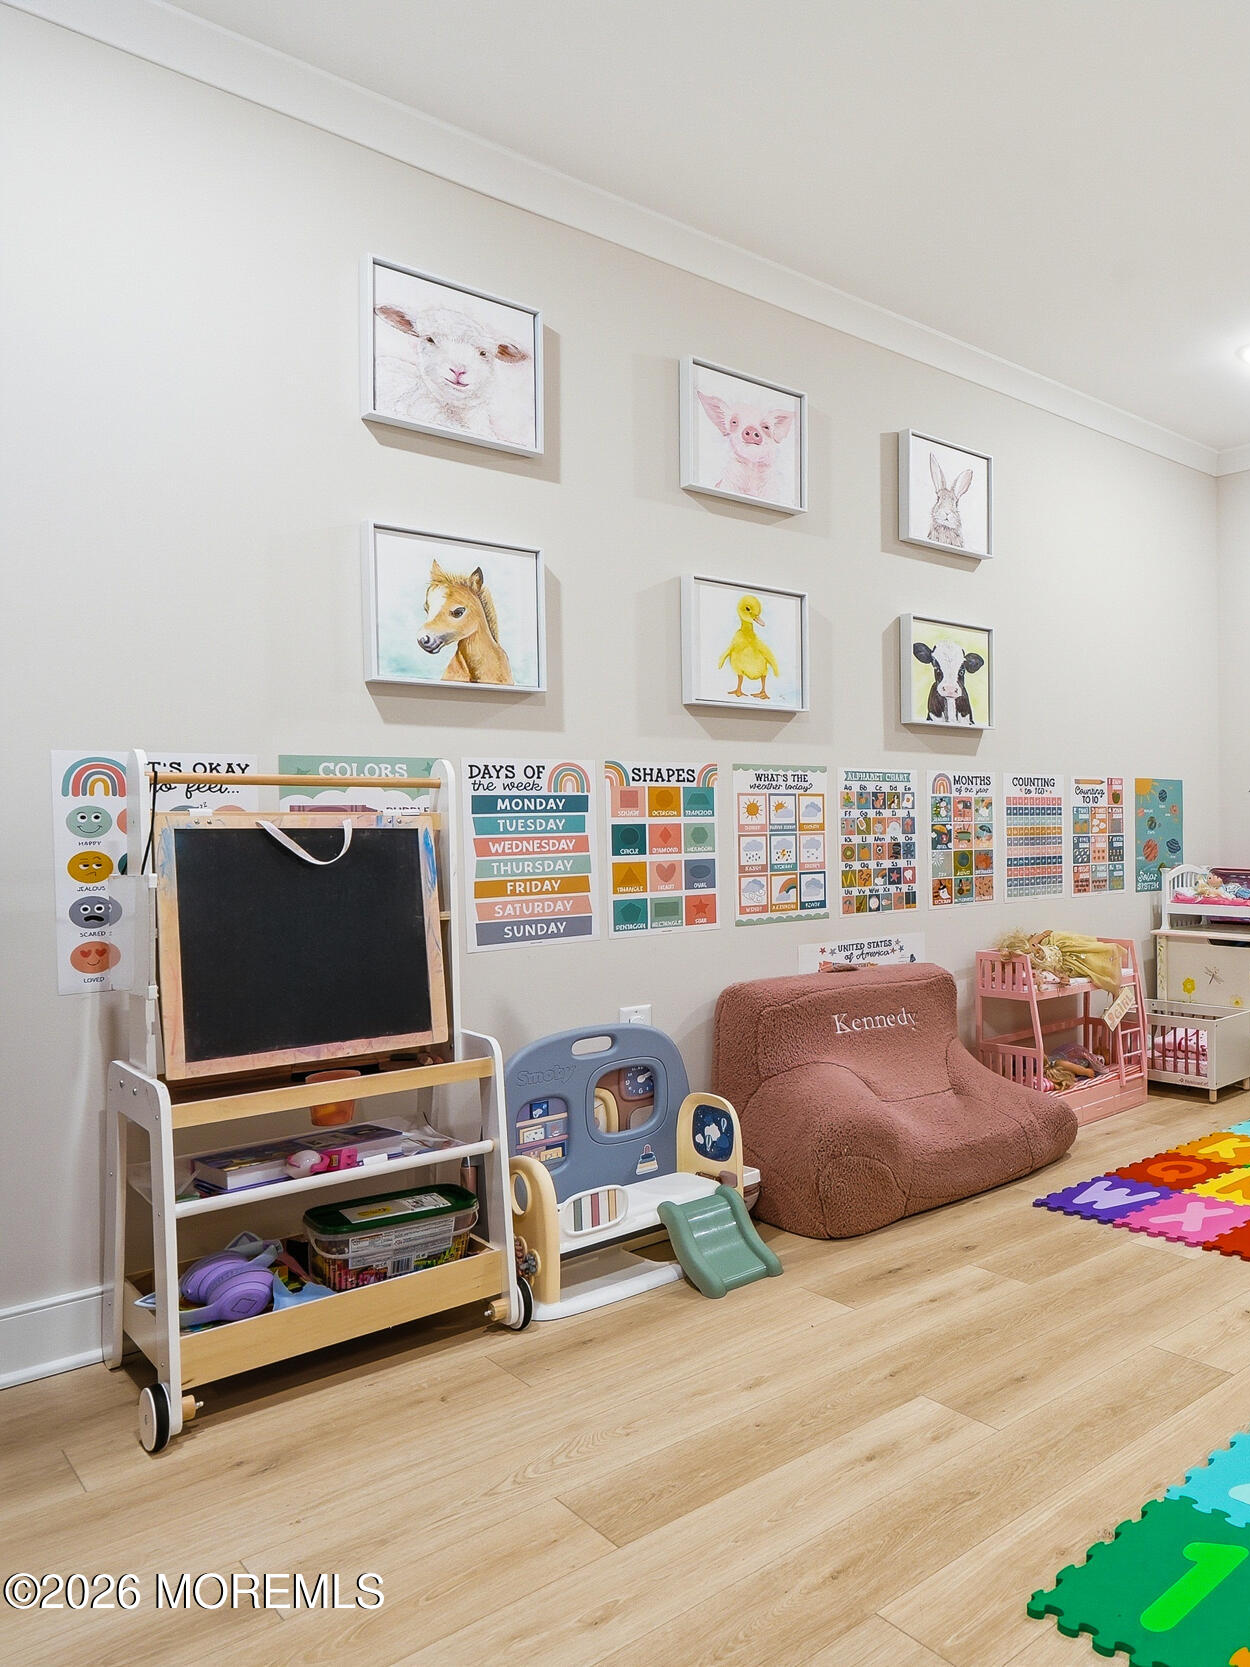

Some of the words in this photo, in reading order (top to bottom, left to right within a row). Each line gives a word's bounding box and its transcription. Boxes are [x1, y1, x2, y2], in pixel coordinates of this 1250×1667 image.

[147, 761, 182, 773] T'S
[192, 762, 250, 774] OKAY
[319, 762, 408, 778] COLORS
[468, 764, 516, 780] DAYS
[523, 765, 546, 779] OF
[631, 767, 697, 783] SHAPES
[754, 773, 789, 783] WHAT'S
[791, 773, 809, 783] THE
[953, 775, 992, 786] MONTHS
[1012, 777, 1056, 787] COUNTING
[471, 779, 497, 792] the
[502, 780, 543, 792] week
[749, 782, 783, 791] weather
[784, 782, 814, 792] today?
[955, 785, 963, 795] of
[1074, 785, 1106, 798] Counting
[496, 798, 566, 811] MONDAY
[1081, 795, 1091, 804] TO
[1091, 795, 1099, 804] 10
[497, 818, 566, 832] TUESDAY
[488, 839, 576, 854] WEDNESDAY
[490, 859, 574, 875] THURSDAY
[1137, 870, 1158, 882] Solar
[506, 879, 561, 895] FRIDAY
[494, 900, 574, 917] SATURDAY
[79, 930, 106, 938] SCARED
[503, 921, 567, 938] SUNDAY
[837, 942, 865, 953] UNITED
[867, 939, 893, 949] STATES
[844, 952, 855, 963] of
[855, 949, 890, 961] America
[83, 976, 106, 984] LOVED
[832, 1007, 917, 1035] Kennedy
[517, 1064, 572, 1087] Smoby
[1147, 1161, 1207, 1182] Q
[1072, 1181, 1160, 1209] W
[1148, 1202, 1234, 1231] X
[1139, 1541, 1250, 1633] 1
